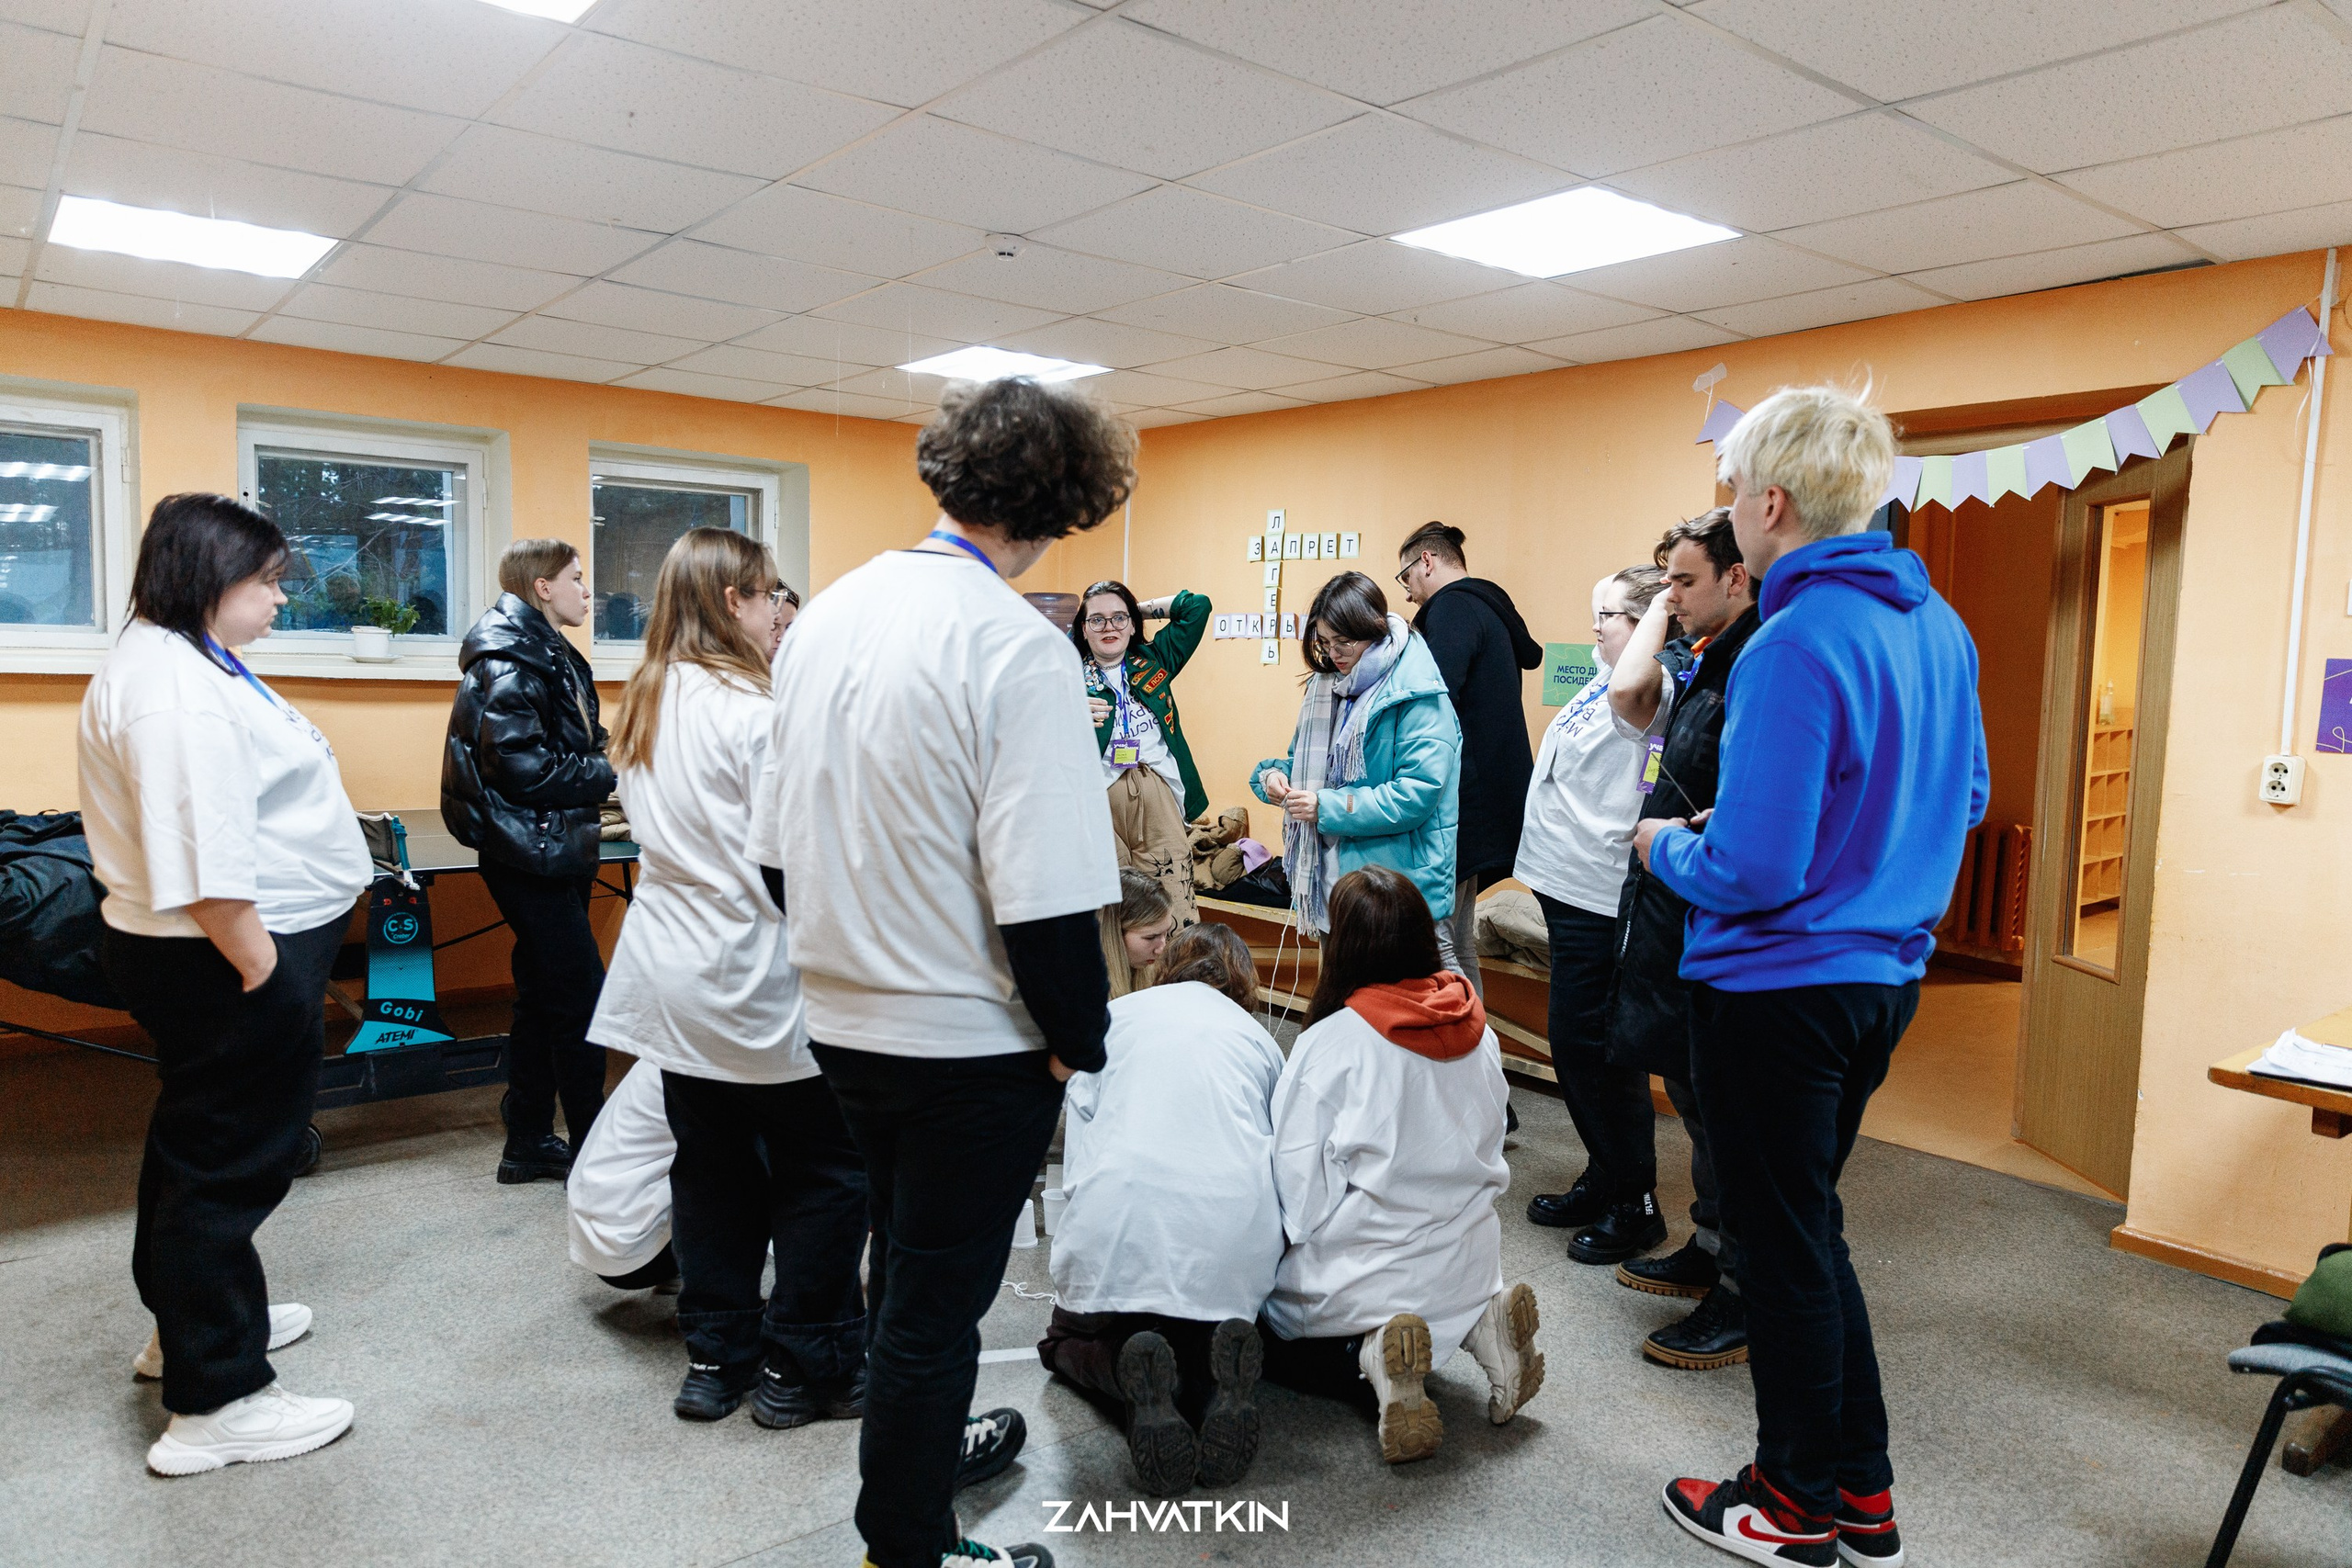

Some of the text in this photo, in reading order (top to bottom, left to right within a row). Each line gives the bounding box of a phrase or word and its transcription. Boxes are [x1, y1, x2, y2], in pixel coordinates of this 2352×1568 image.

[1253, 538, 1354, 556] ЗАПРЕТ
[1268, 515, 1282, 659] ЛАГЕРЬ
[1219, 618, 1295, 634] ОТКРЫ
[1556, 665, 1587, 675] МЕСТО
[1553, 674, 1593, 686] ПОСИДЕ
[379, 1001, 424, 1022] Gobi
[375, 1029, 416, 1044] ATEMI
